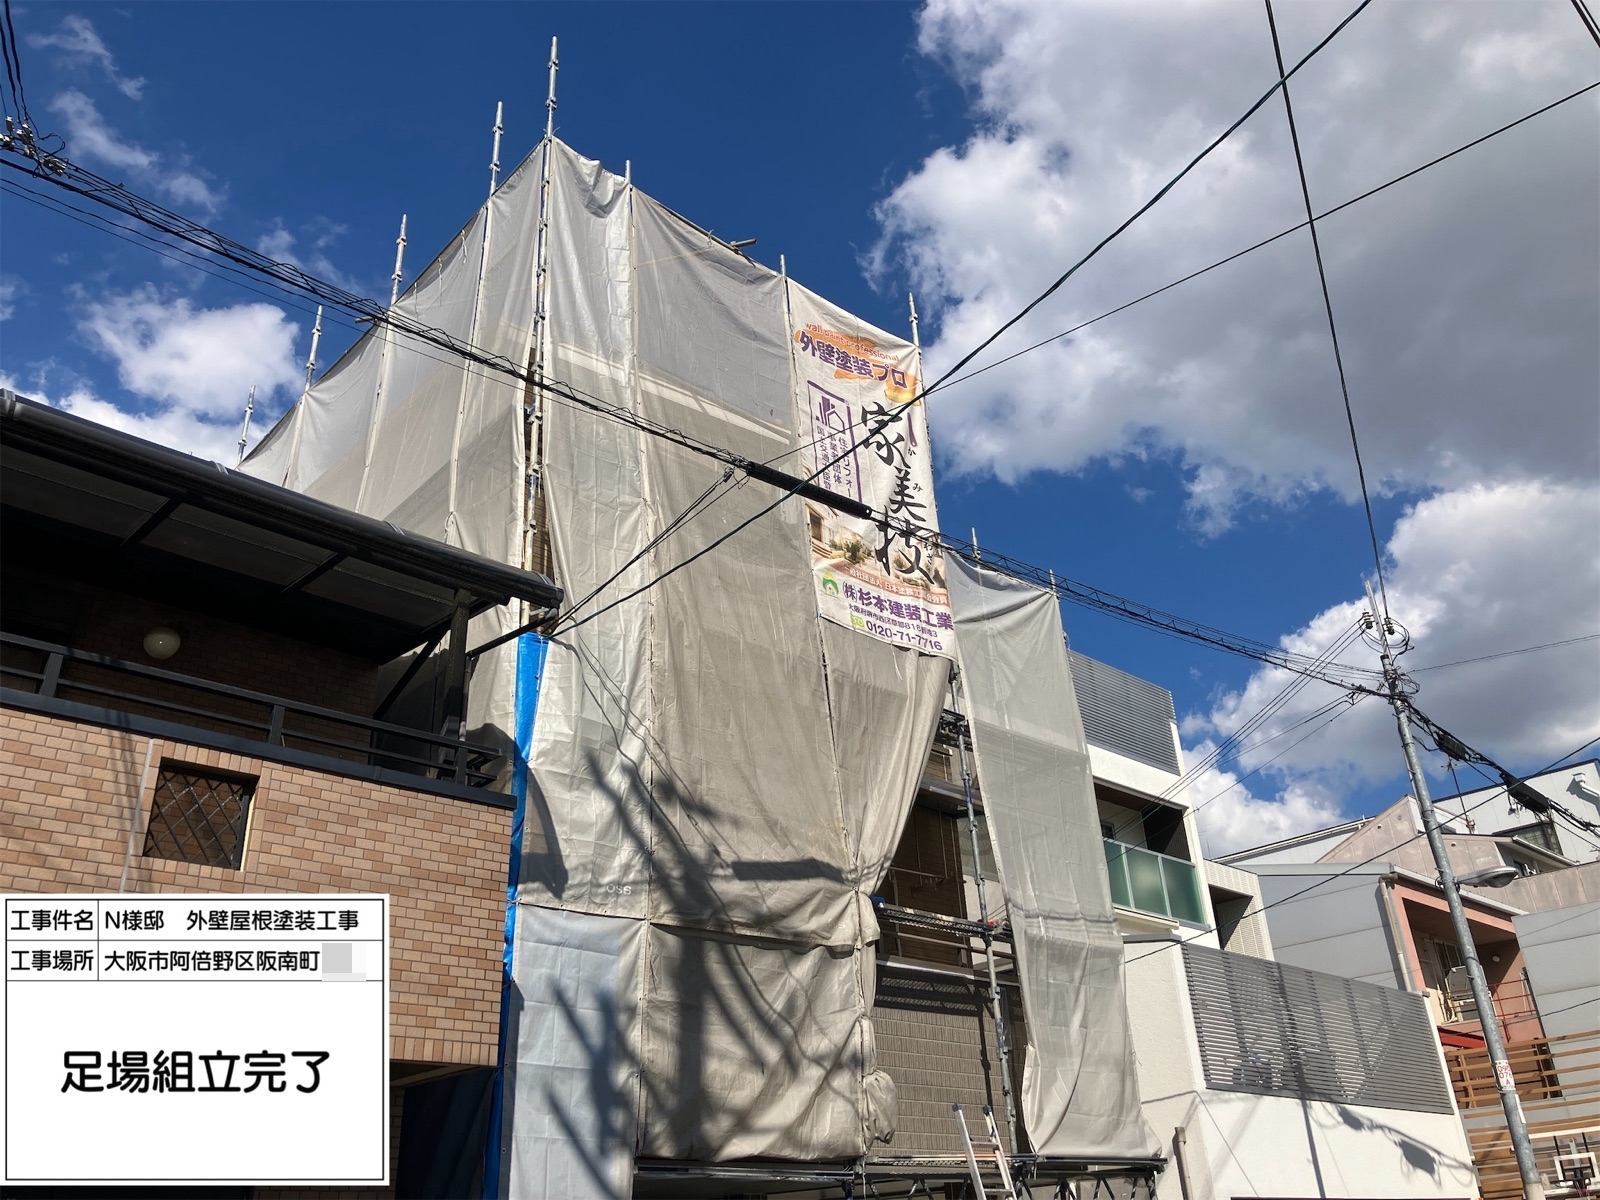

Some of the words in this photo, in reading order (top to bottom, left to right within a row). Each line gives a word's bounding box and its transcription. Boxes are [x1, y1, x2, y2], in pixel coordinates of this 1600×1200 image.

[804, 322, 823, 333] wall
[800, 331, 908, 388] 外壁塗装プロ
[865, 620, 943, 651] 0120-71-7716
